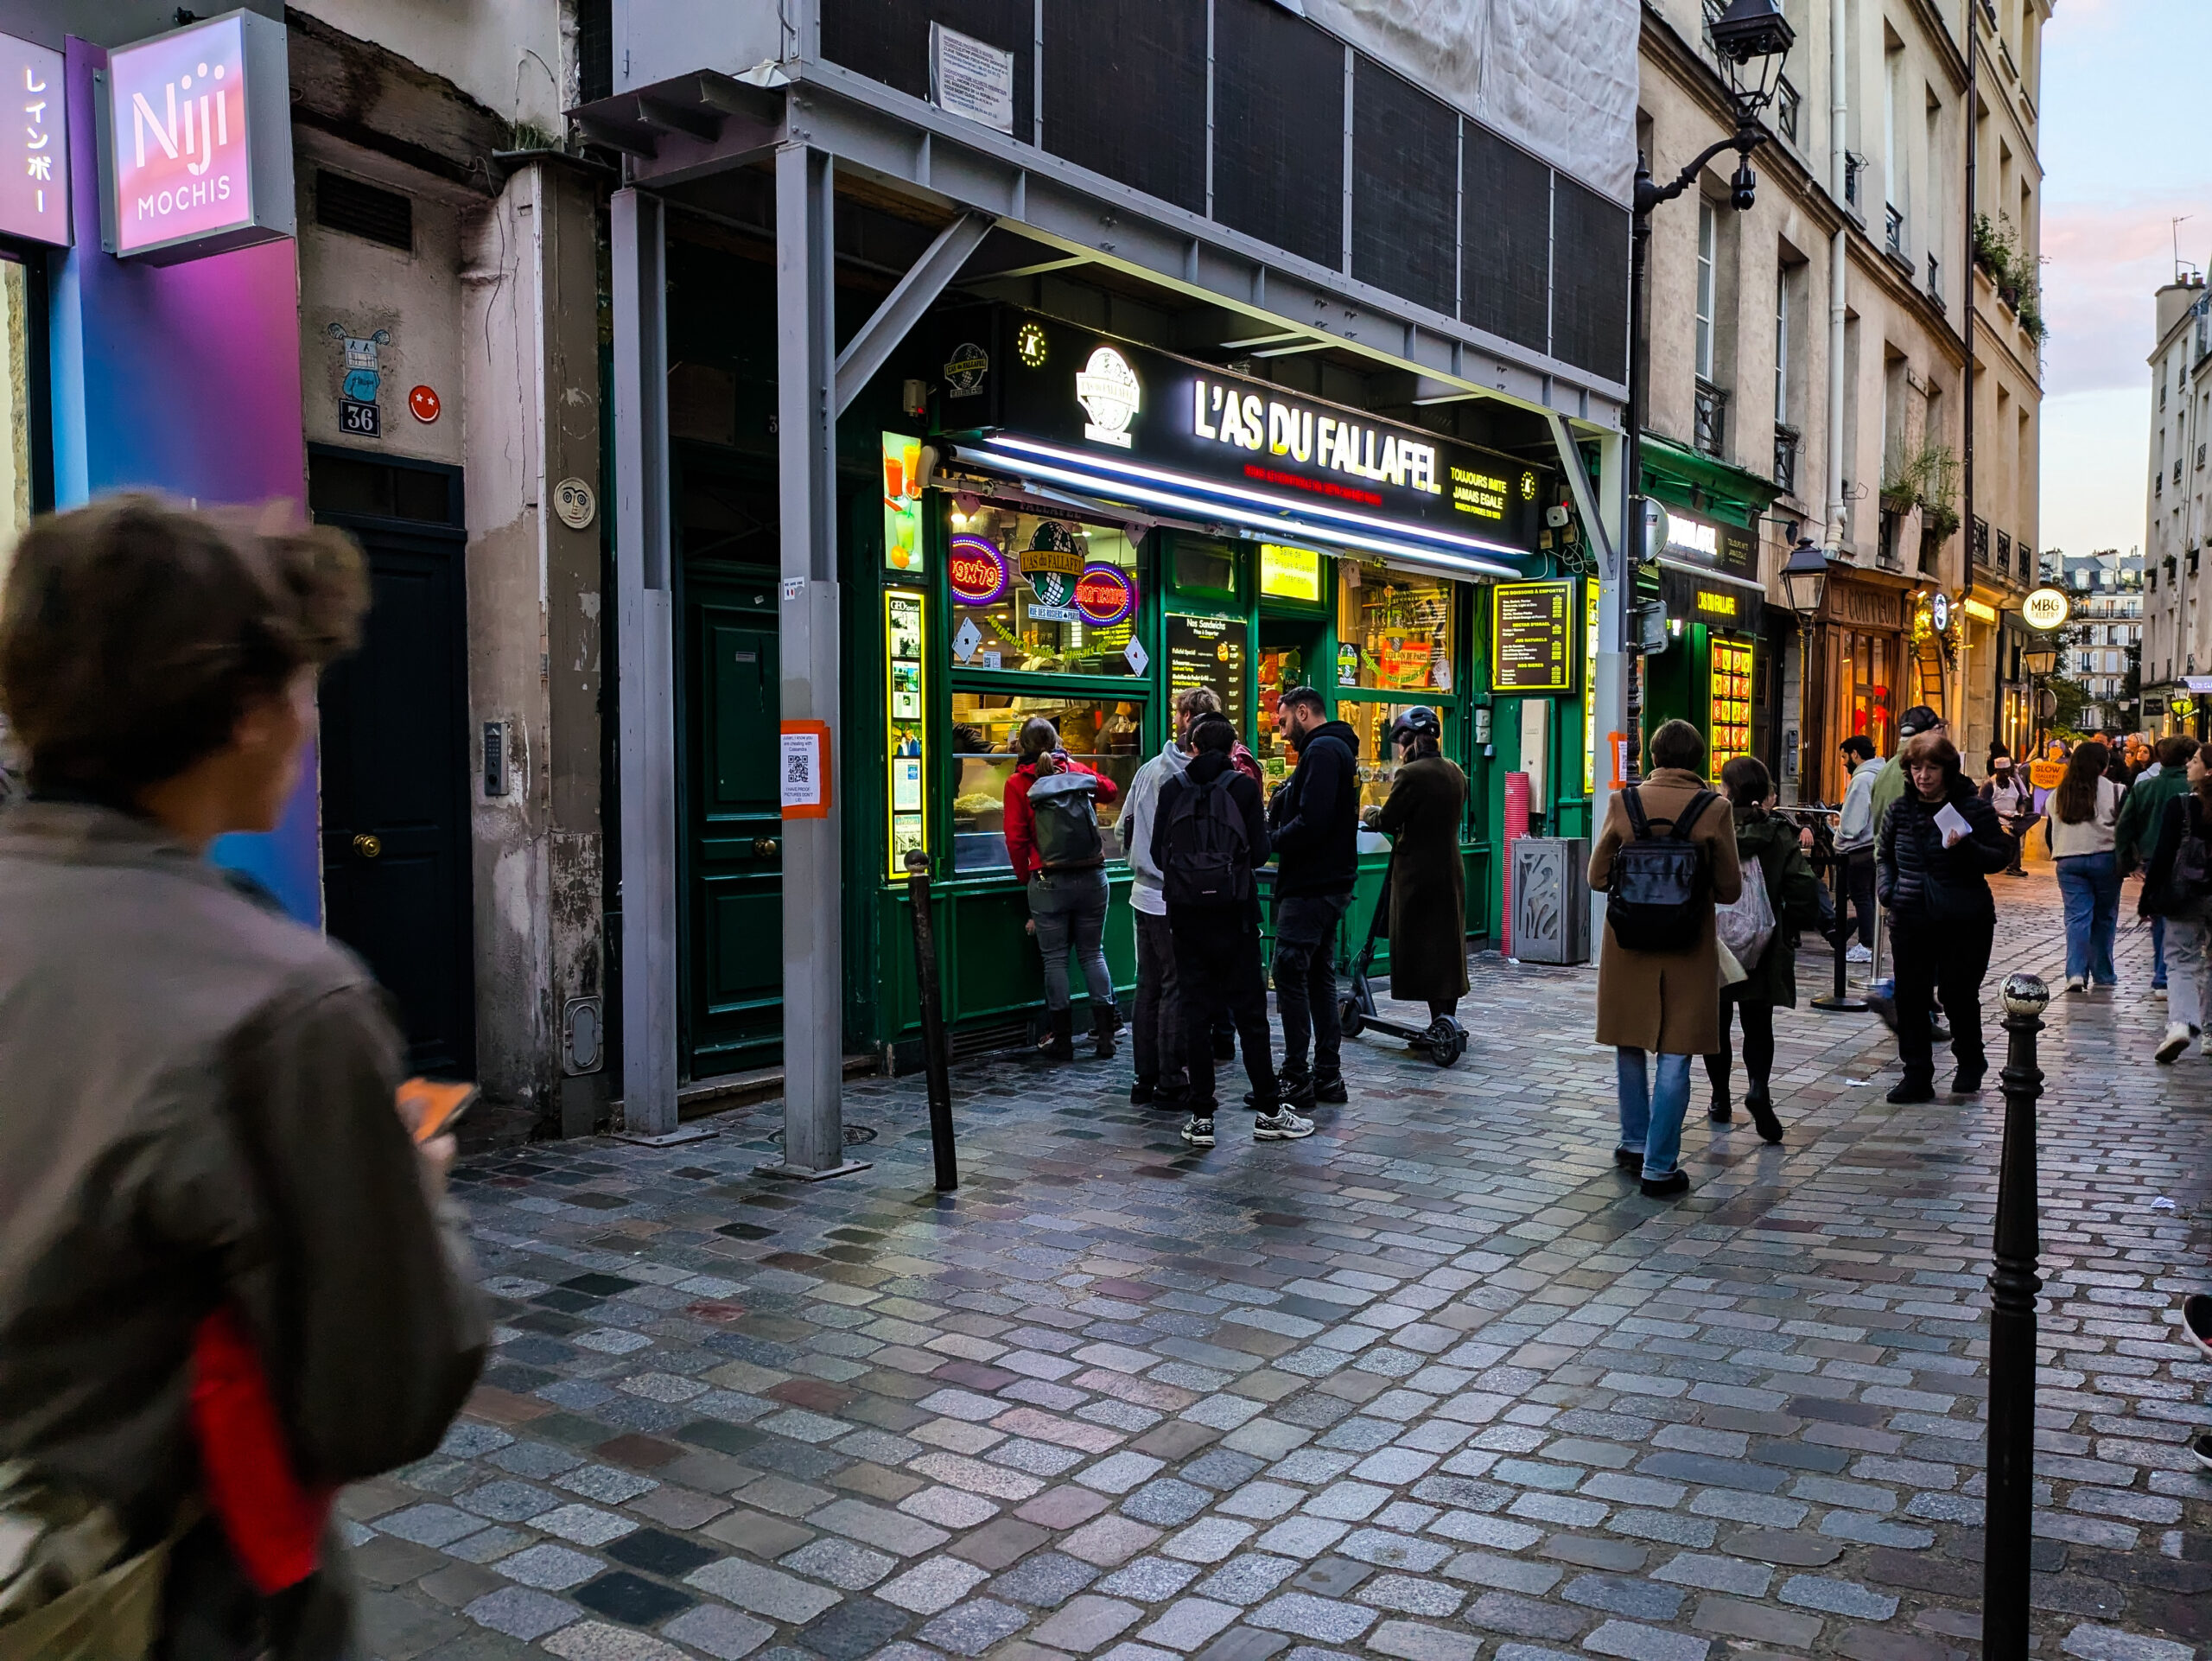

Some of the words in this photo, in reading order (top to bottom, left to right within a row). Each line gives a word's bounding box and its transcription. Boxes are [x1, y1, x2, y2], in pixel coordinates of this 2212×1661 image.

[132, 62, 227, 176] Niji
[25, 69, 51, 213] レインボー
[137, 175, 232, 220] MOCHIS
[1024, 334, 1039, 356] K
[347, 405, 373, 430] 36
[1194, 380, 1264, 450] L'AS
[1268, 402, 1312, 462] DU
[1318, 416, 1441, 494] FALLAFEL
[1451, 467, 1487, 488] TOUJOURS
[1453, 486, 1479, 504] JAMAIS
[1480, 493, 1503, 509] EGALE
[952, 559, 997, 588] פלאפ
[1022, 555, 1038, 570] L'AS
[1039, 553, 1047, 566] du
[1048, 556, 1084, 575] FALLAFEL
[890, 601, 906, 610] GEO
[1046, 609, 1063, 618] ROSIERS
[1068, 611, 1079, 620] PARIS
[2031, 598, 2059, 612] MBG
[1187, 618, 1198, 627] Nos
[2035, 765, 2060, 773] SLOW
